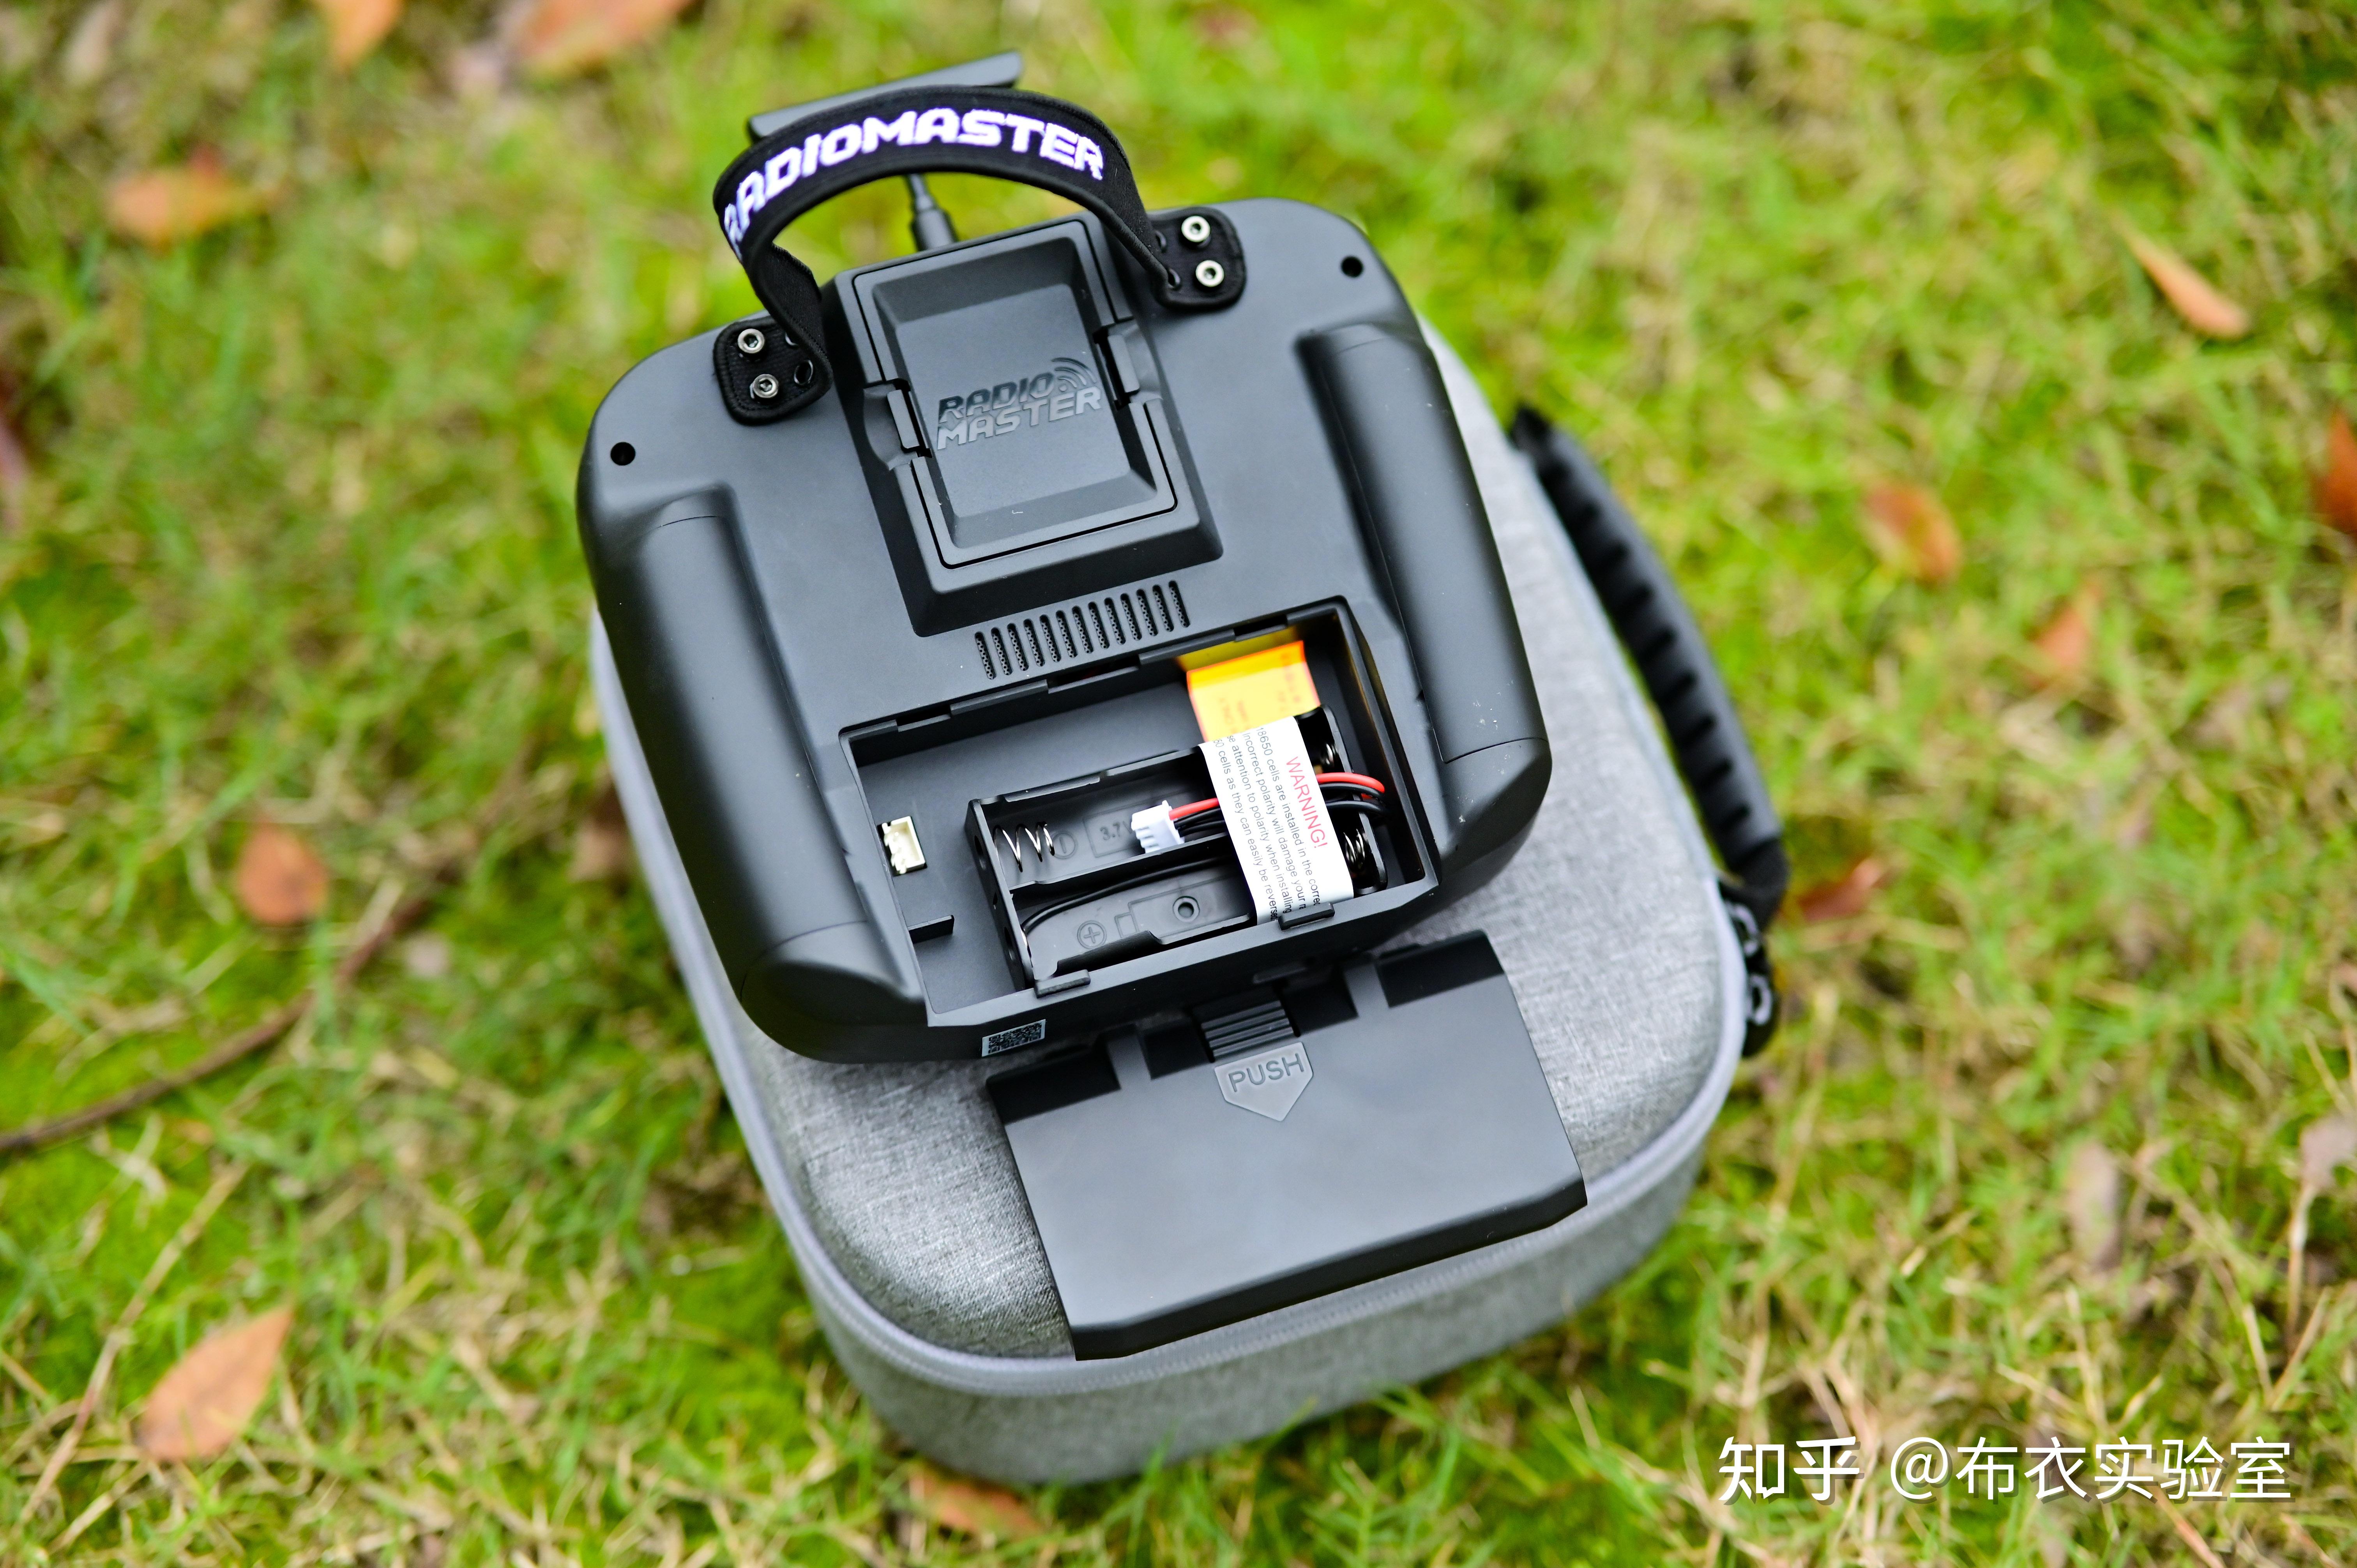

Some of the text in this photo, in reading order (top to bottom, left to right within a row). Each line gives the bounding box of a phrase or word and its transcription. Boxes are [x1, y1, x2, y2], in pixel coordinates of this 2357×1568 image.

[724, 108, 1104, 260] RADIOMASTER
[939, 372, 1054, 423] RADIO
[937, 387, 1102, 450] MASTER
[1232, 745, 1251, 790] attention
[1242, 733, 1264, 776] Incorrect
[1219, 750, 1231, 774] cells
[1227, 777, 1236, 790] as
[1232, 793, 1244, 814] they
[1240, 818, 1252, 835] can
[1247, 838, 1263, 866] easily
[1258, 869, 1268, 882] be
[1247, 793, 1255, 802] to
[1256, 779, 1276, 816] polarity
[1256, 727, 1273, 756] 18650
[1267, 759, 1279, 782] cells
[1275, 784, 1286, 801] are
[1282, 803, 1304, 845] installed
[1298, 848, 1306, 857] in
[1302, 860, 1313, 876] the
[1286, 756, 1328, 848] WARNING!
[1249, 805, 1269, 841] polarity
[1272, 818, 1285, 834] will
[1266, 844, 1280, 872] when
[1278, 837, 1297, 877] damage
[1276, 873, 1293, 913] installing
[1291, 880, 1306, 901] your
[1228, 1053, 1304, 1092] PUSH
